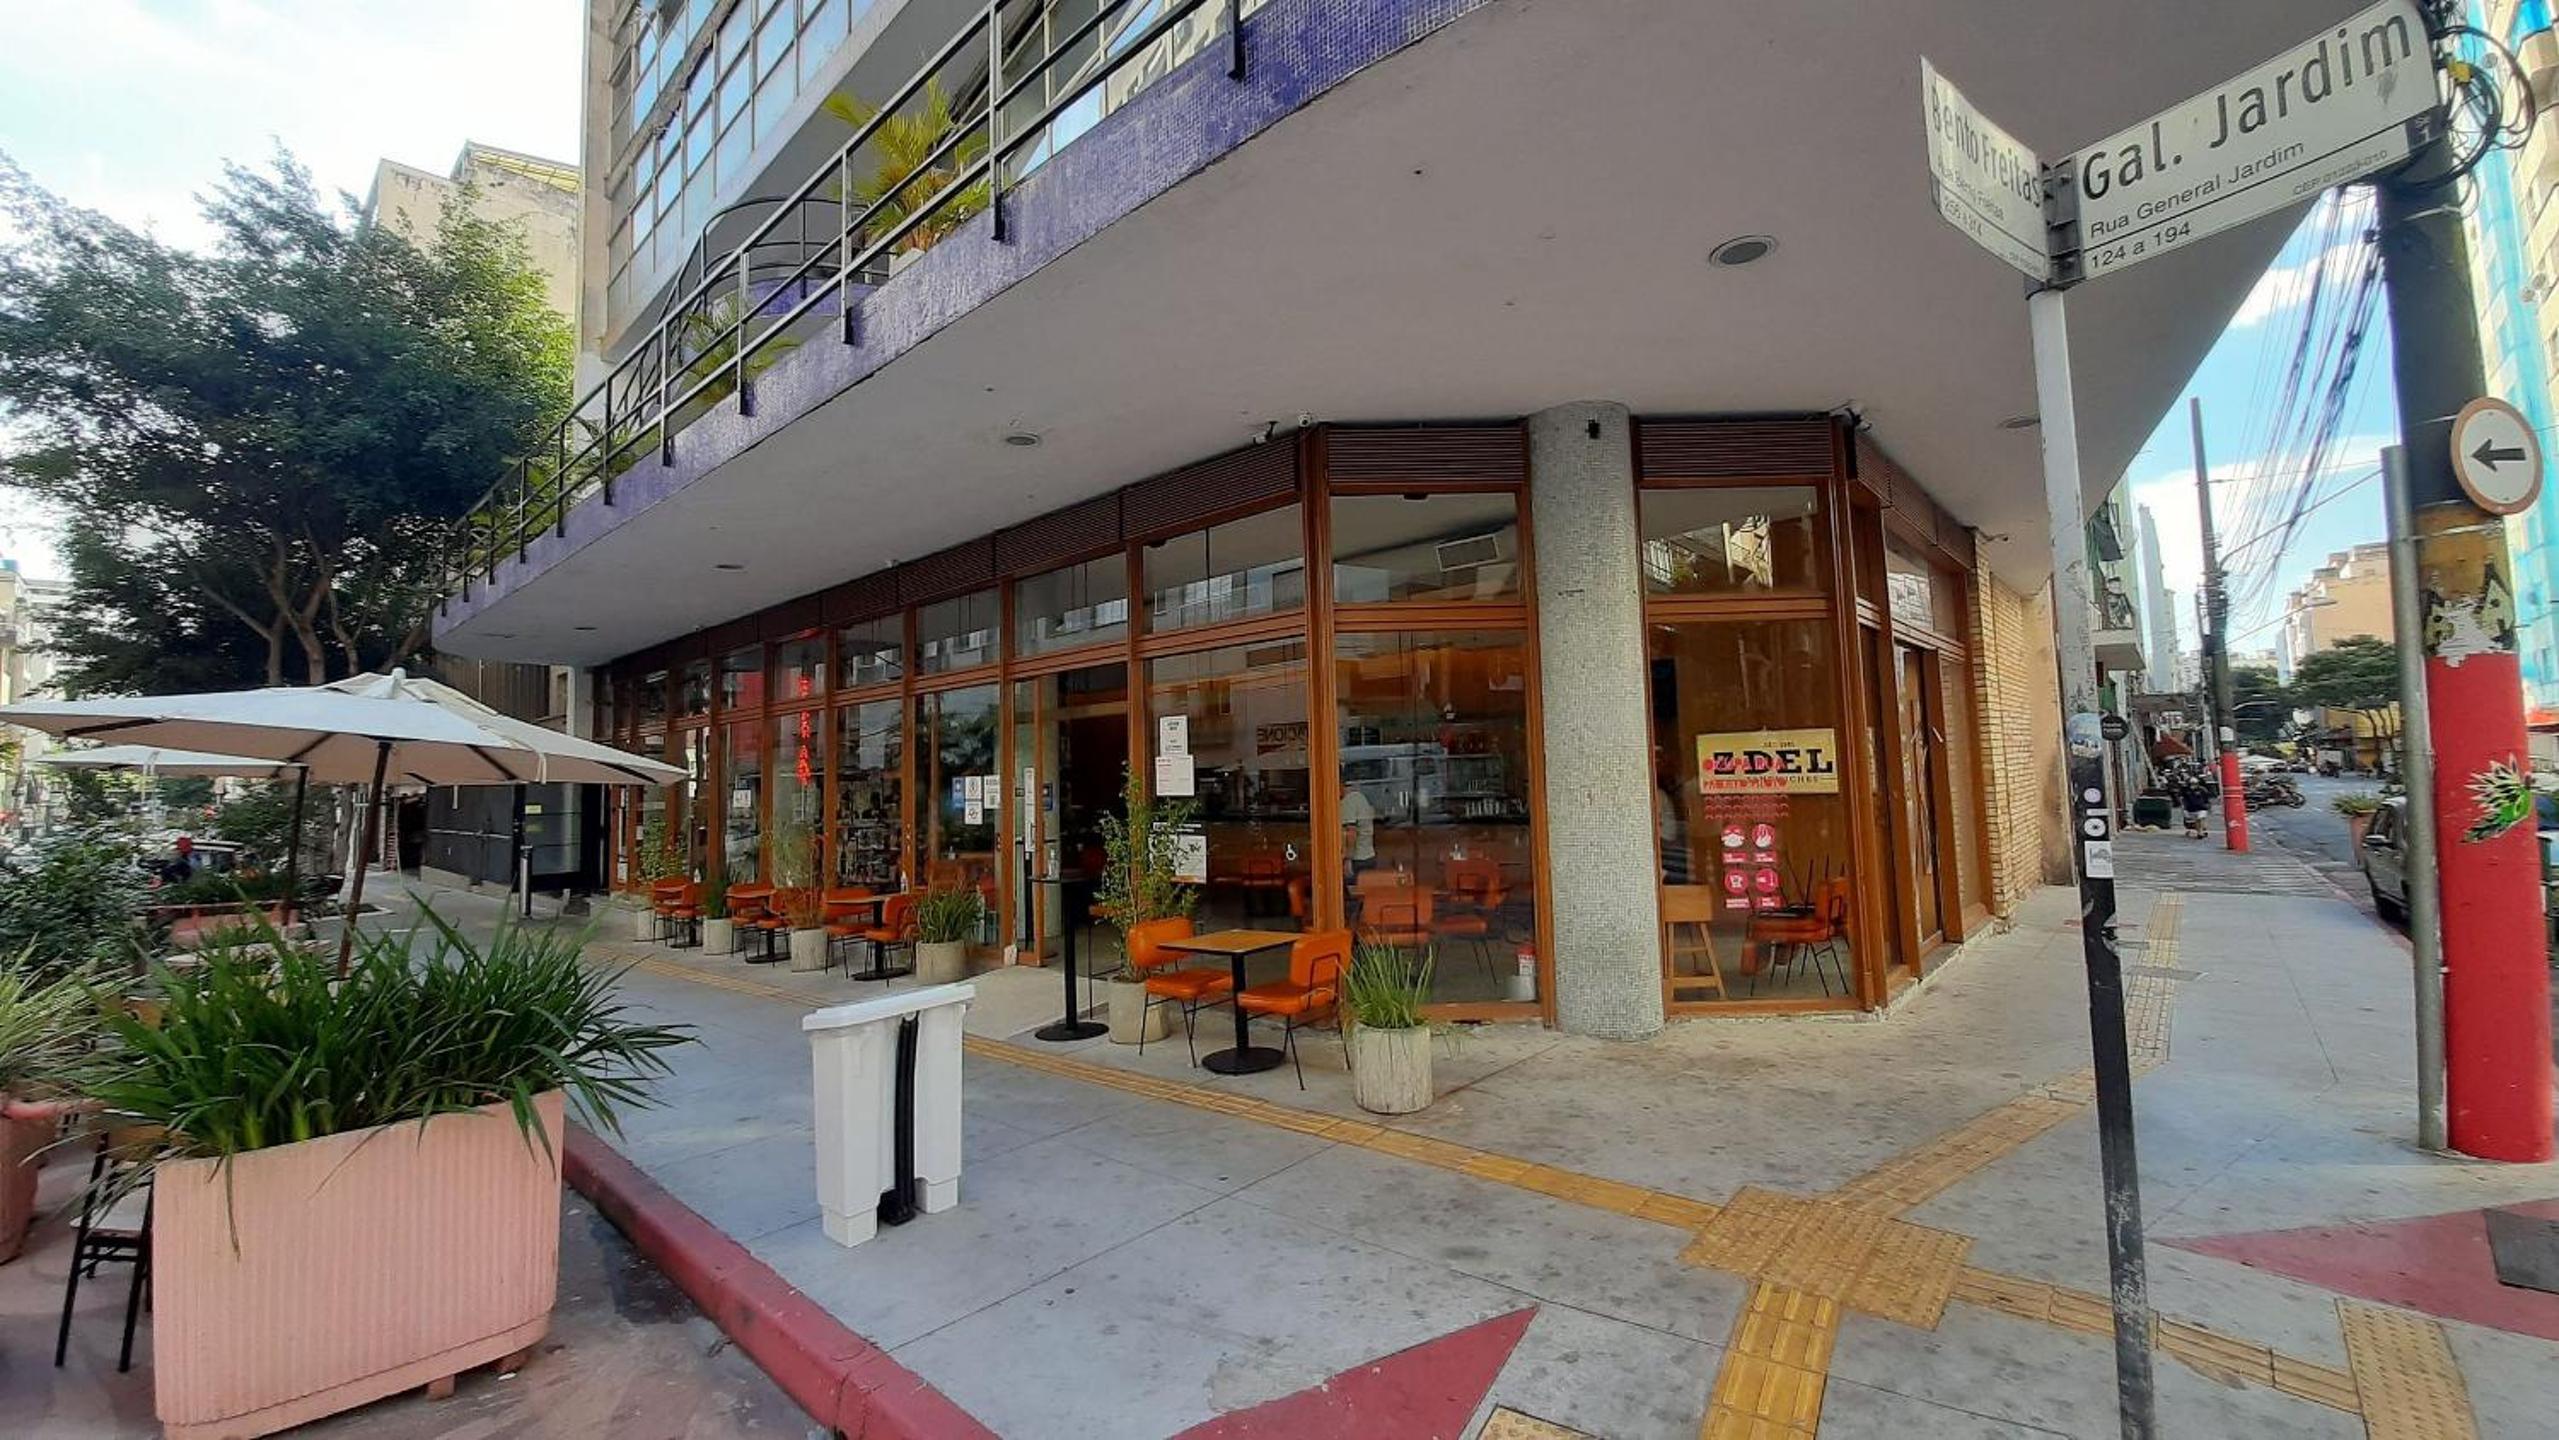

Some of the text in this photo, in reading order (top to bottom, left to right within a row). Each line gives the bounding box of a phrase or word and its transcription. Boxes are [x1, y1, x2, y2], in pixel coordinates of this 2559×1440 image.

[1932, 85, 2040, 208] Bento Freitas
[2083, 14, 2411, 200] Gal. Jardim
[2091, 142, 2304, 238] Rua General Jardim
[2293, 177, 2321, 195] CEP
[2092, 221, 2191, 269] 124 a 194
